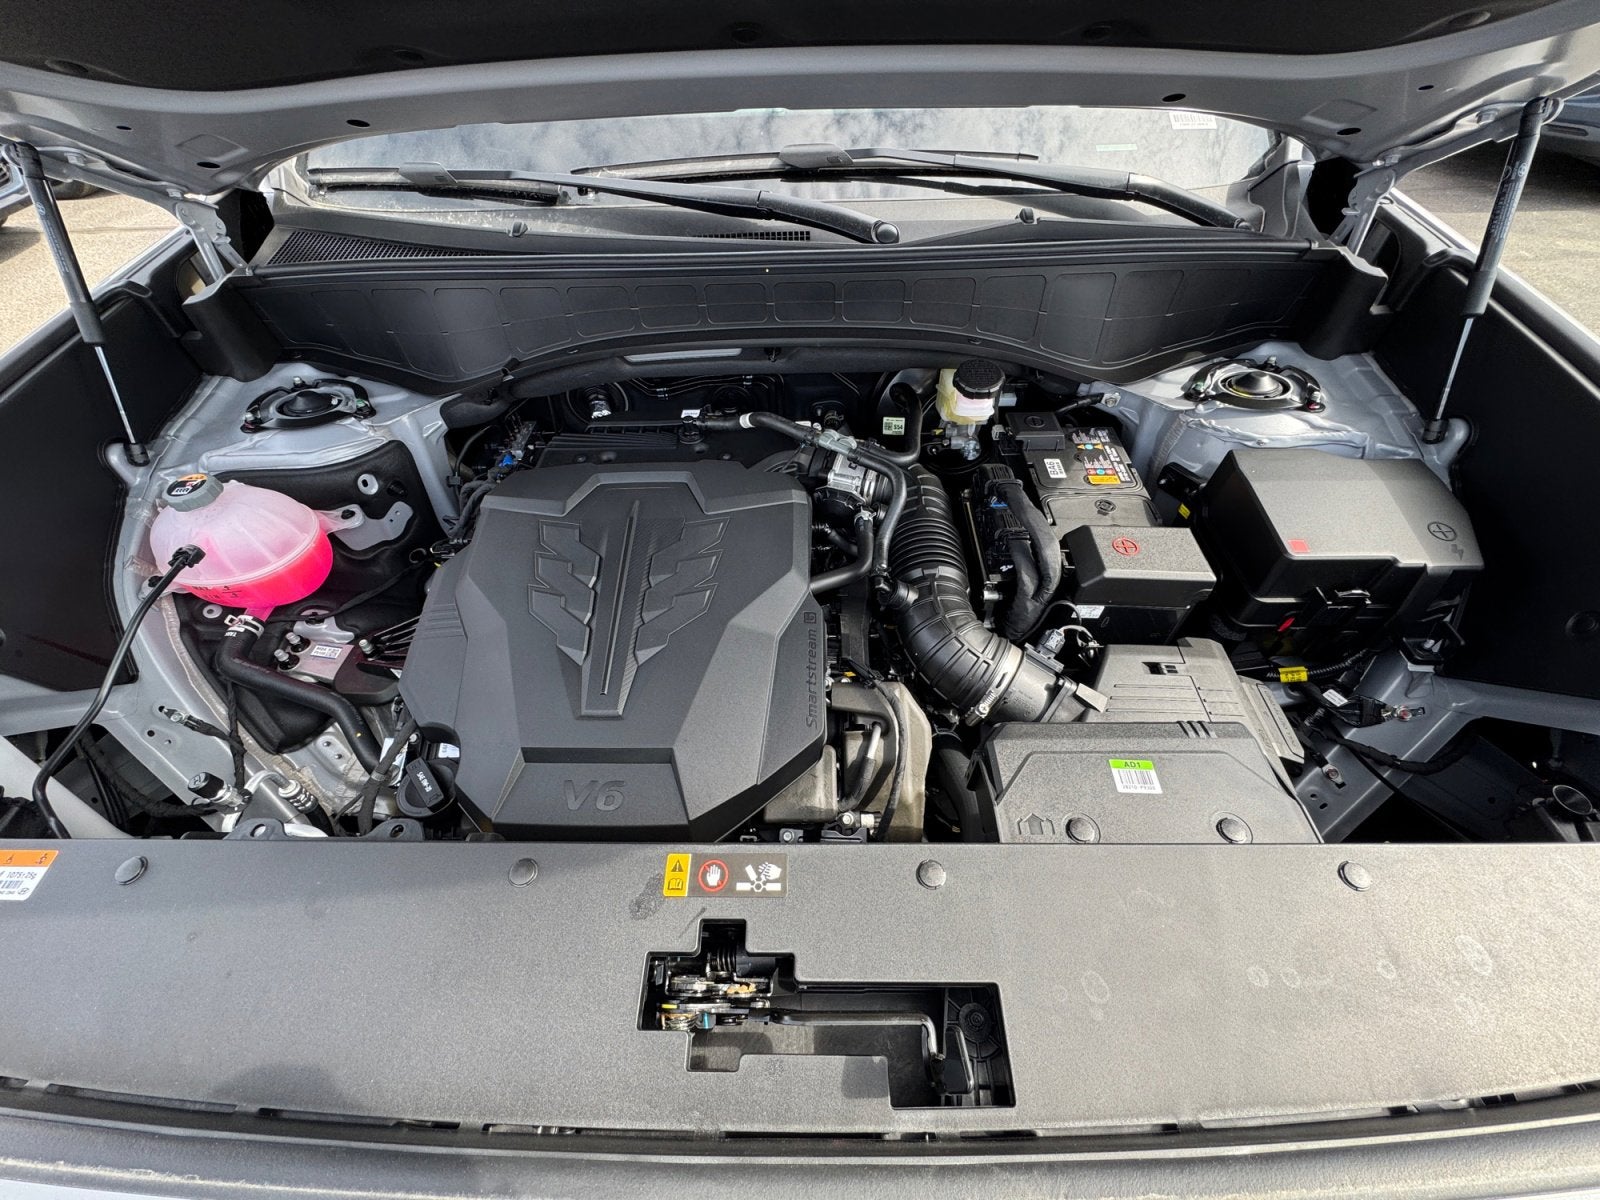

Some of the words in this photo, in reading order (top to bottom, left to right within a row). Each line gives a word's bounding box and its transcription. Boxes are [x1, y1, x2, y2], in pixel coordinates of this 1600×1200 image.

[1046, 461, 1059, 475] BA6
[806, 629, 817, 729] Smartstream
[563, 780, 625, 811] V6
